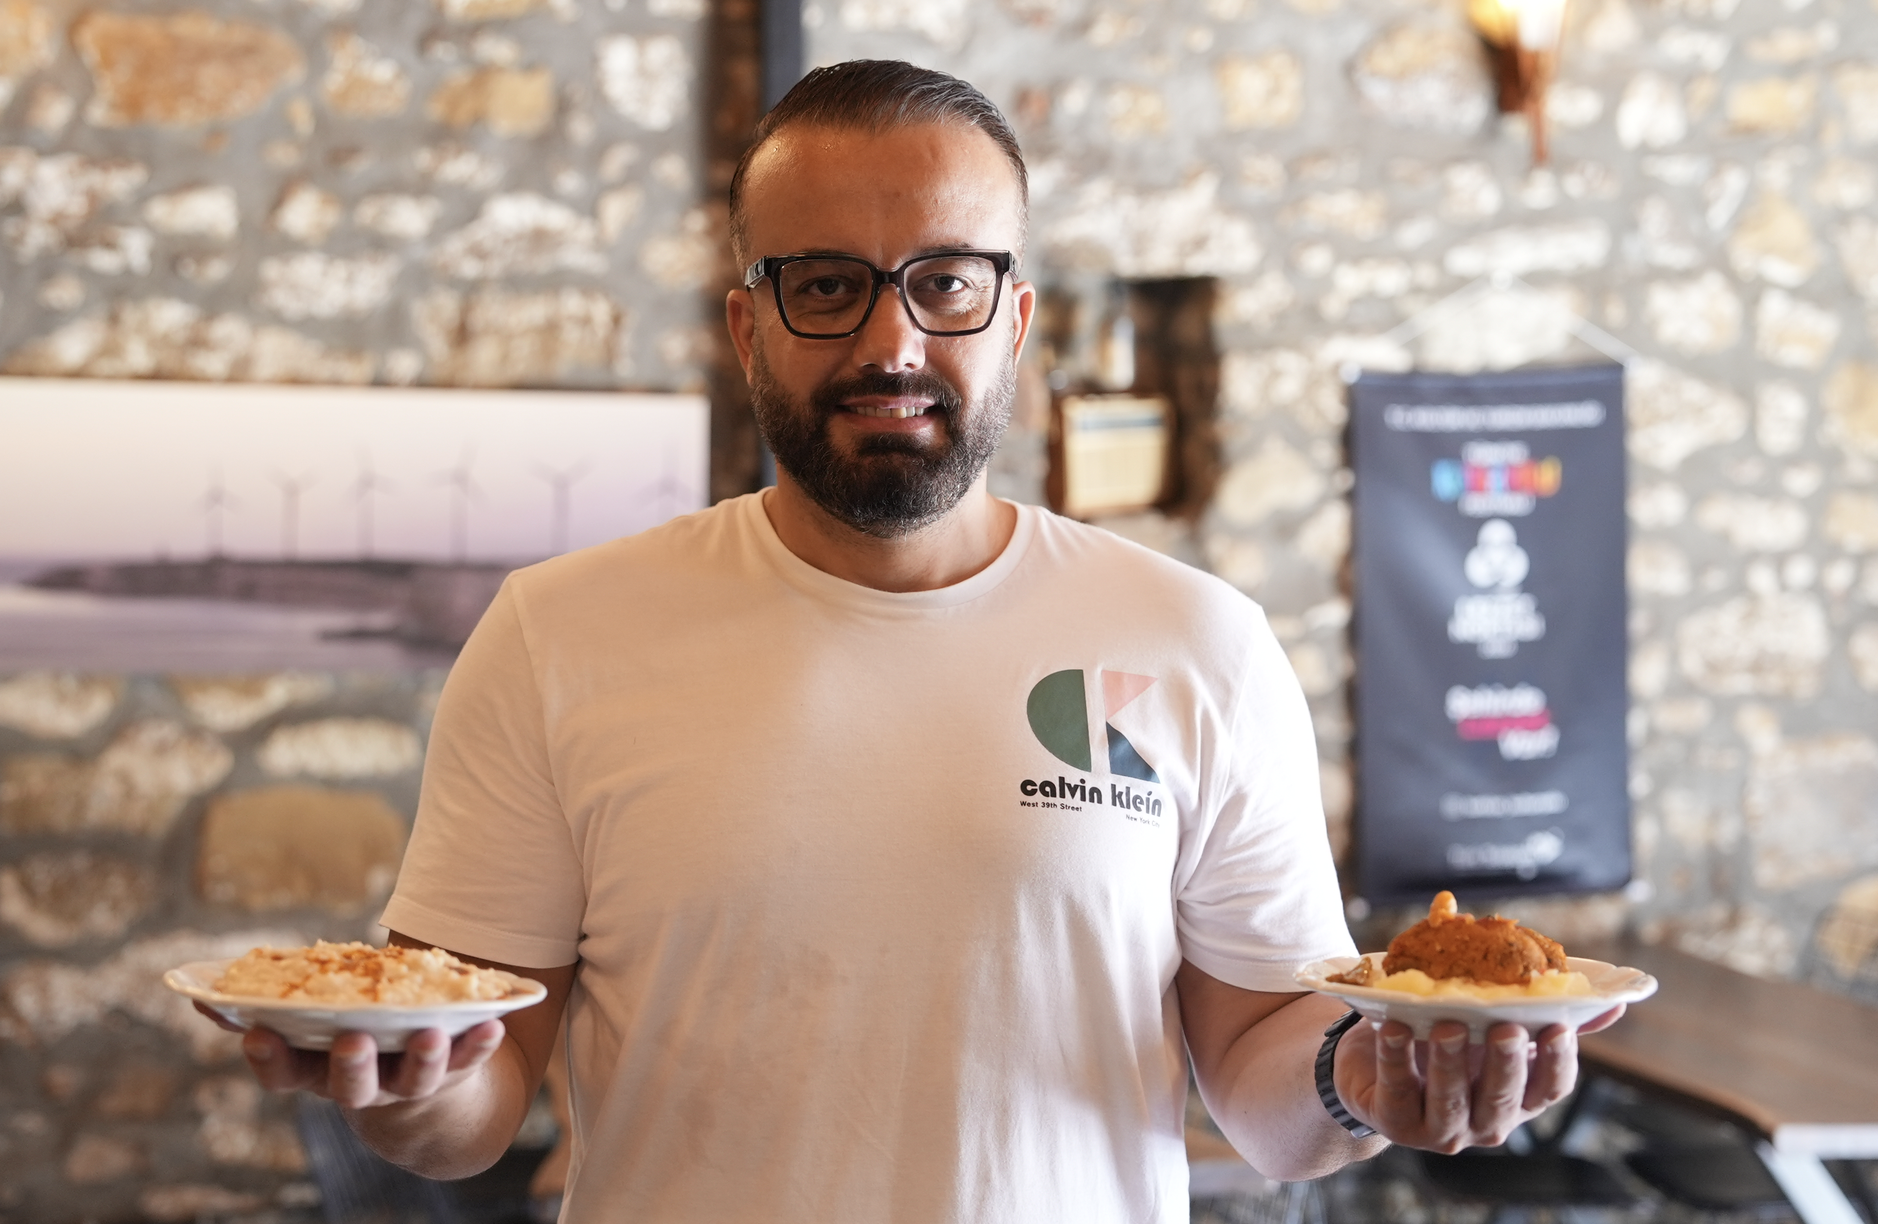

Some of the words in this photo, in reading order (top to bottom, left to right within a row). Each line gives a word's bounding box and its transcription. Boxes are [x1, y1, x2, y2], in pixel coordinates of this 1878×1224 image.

[1020, 776, 1103, 804] calvin
[1111, 783, 1162, 817] klein
[1041, 801, 1058, 809] 39th
[1060, 803, 1083, 812] Street
[1126, 814, 1138, 822] New
[1140, 817, 1150, 825] York
